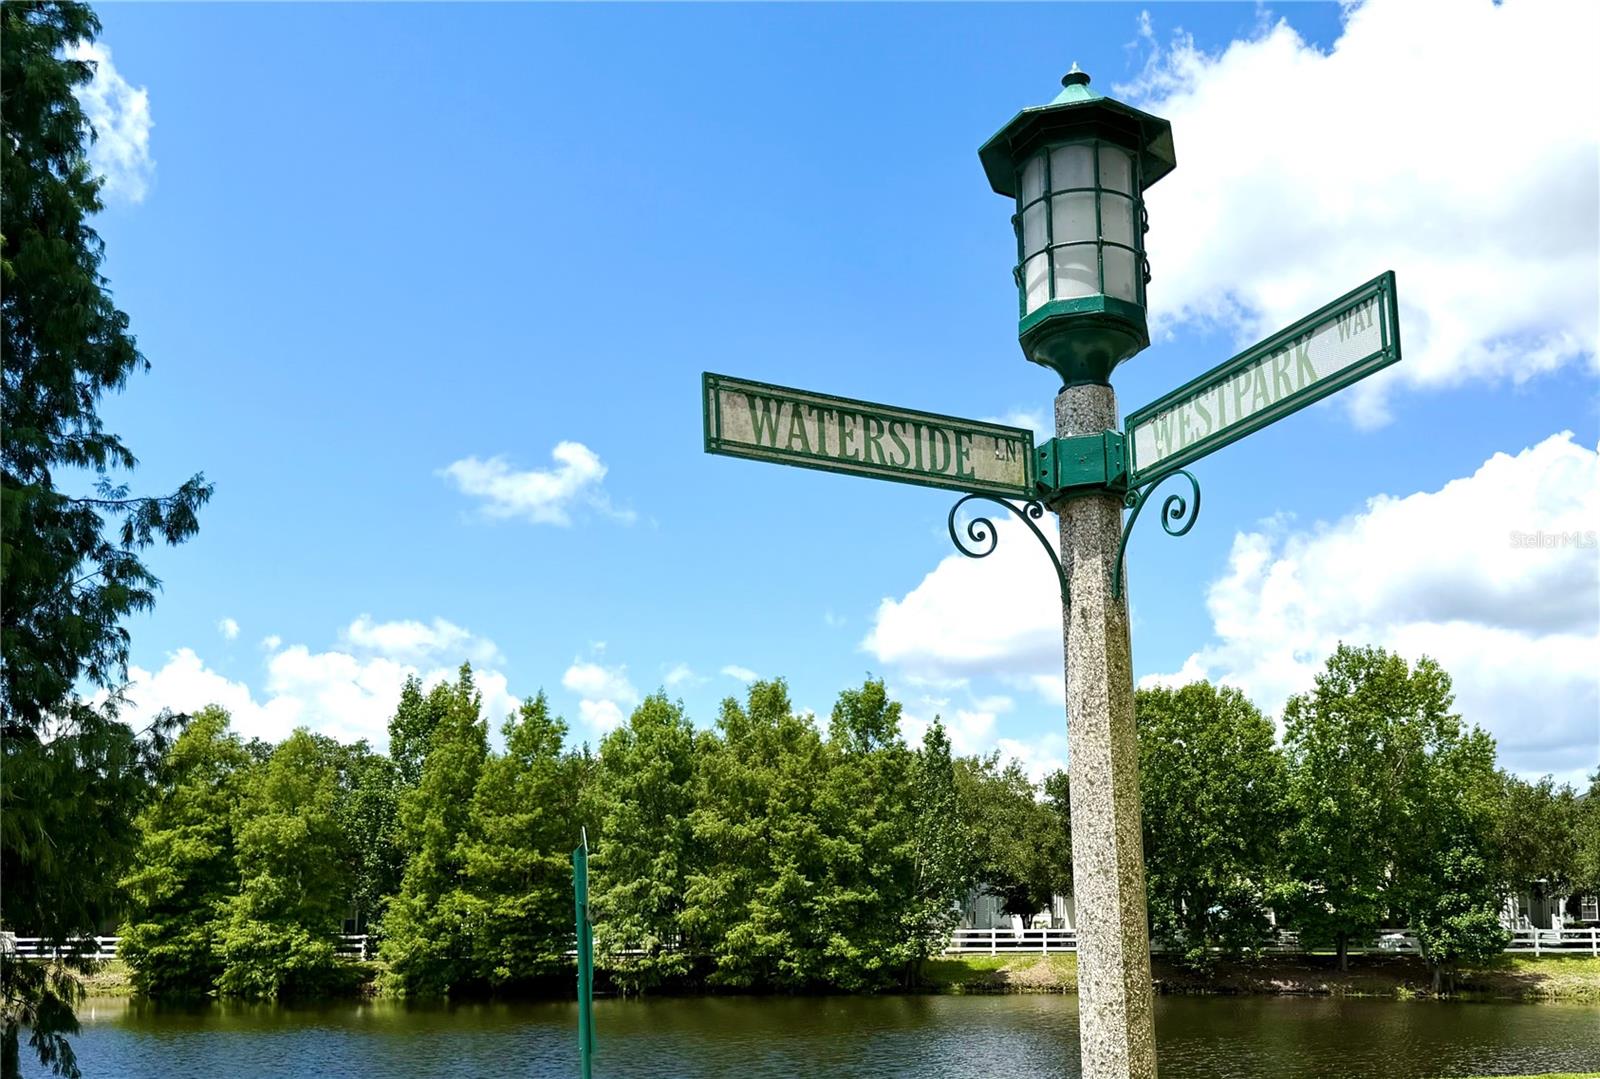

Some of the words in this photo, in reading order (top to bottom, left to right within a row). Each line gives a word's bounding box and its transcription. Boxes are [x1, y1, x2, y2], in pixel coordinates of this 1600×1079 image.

[747, 394, 975, 480] WATERSIDE
[995, 437, 1017, 463] LN
[1152, 328, 1318, 460] WESTPARK
[1334, 297, 1376, 343] WAY
